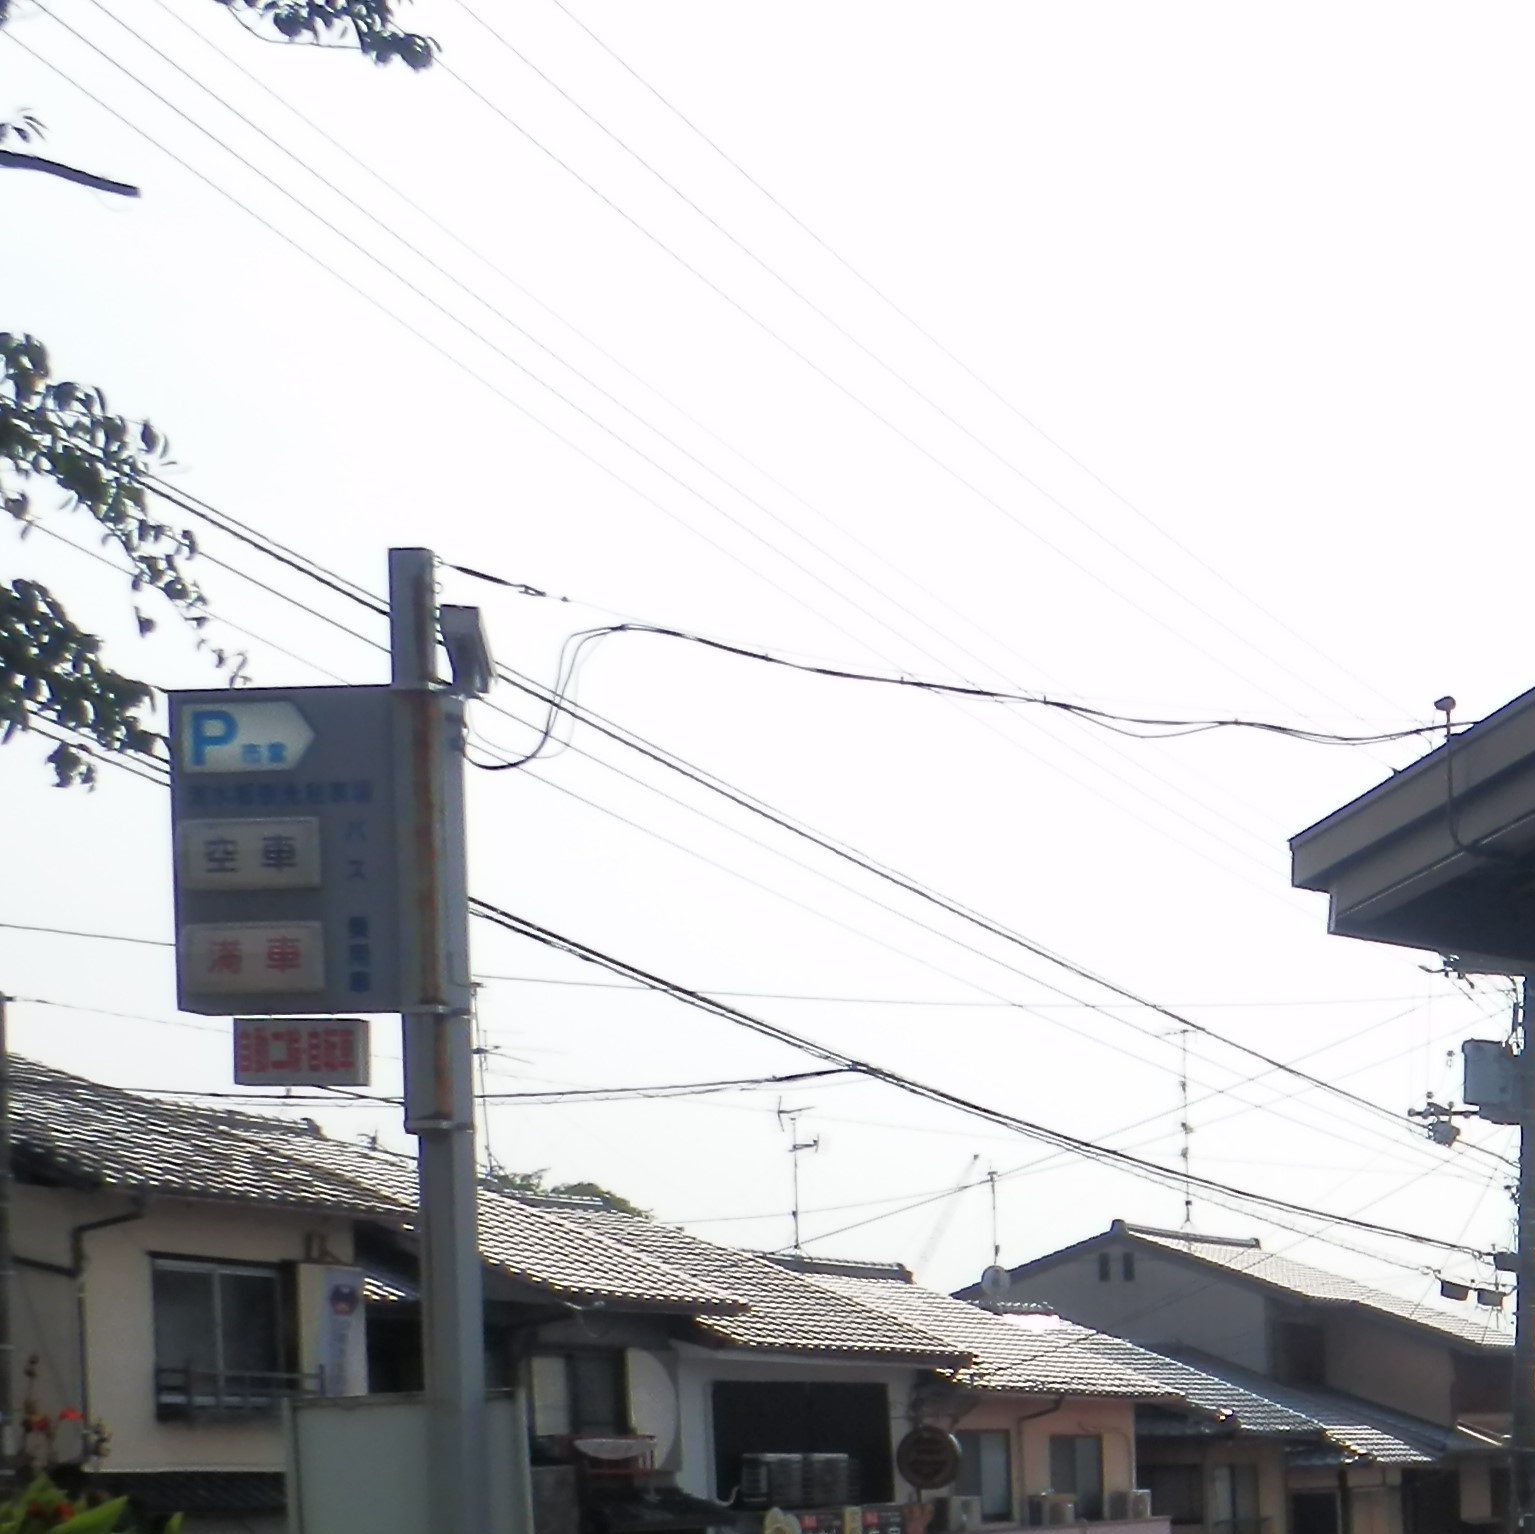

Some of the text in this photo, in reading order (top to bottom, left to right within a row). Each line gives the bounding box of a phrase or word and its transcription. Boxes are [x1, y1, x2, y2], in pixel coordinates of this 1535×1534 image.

[190, 709, 240, 767] P
[204, 835, 297, 874] 空車
[209, 937, 302, 976] 満車
